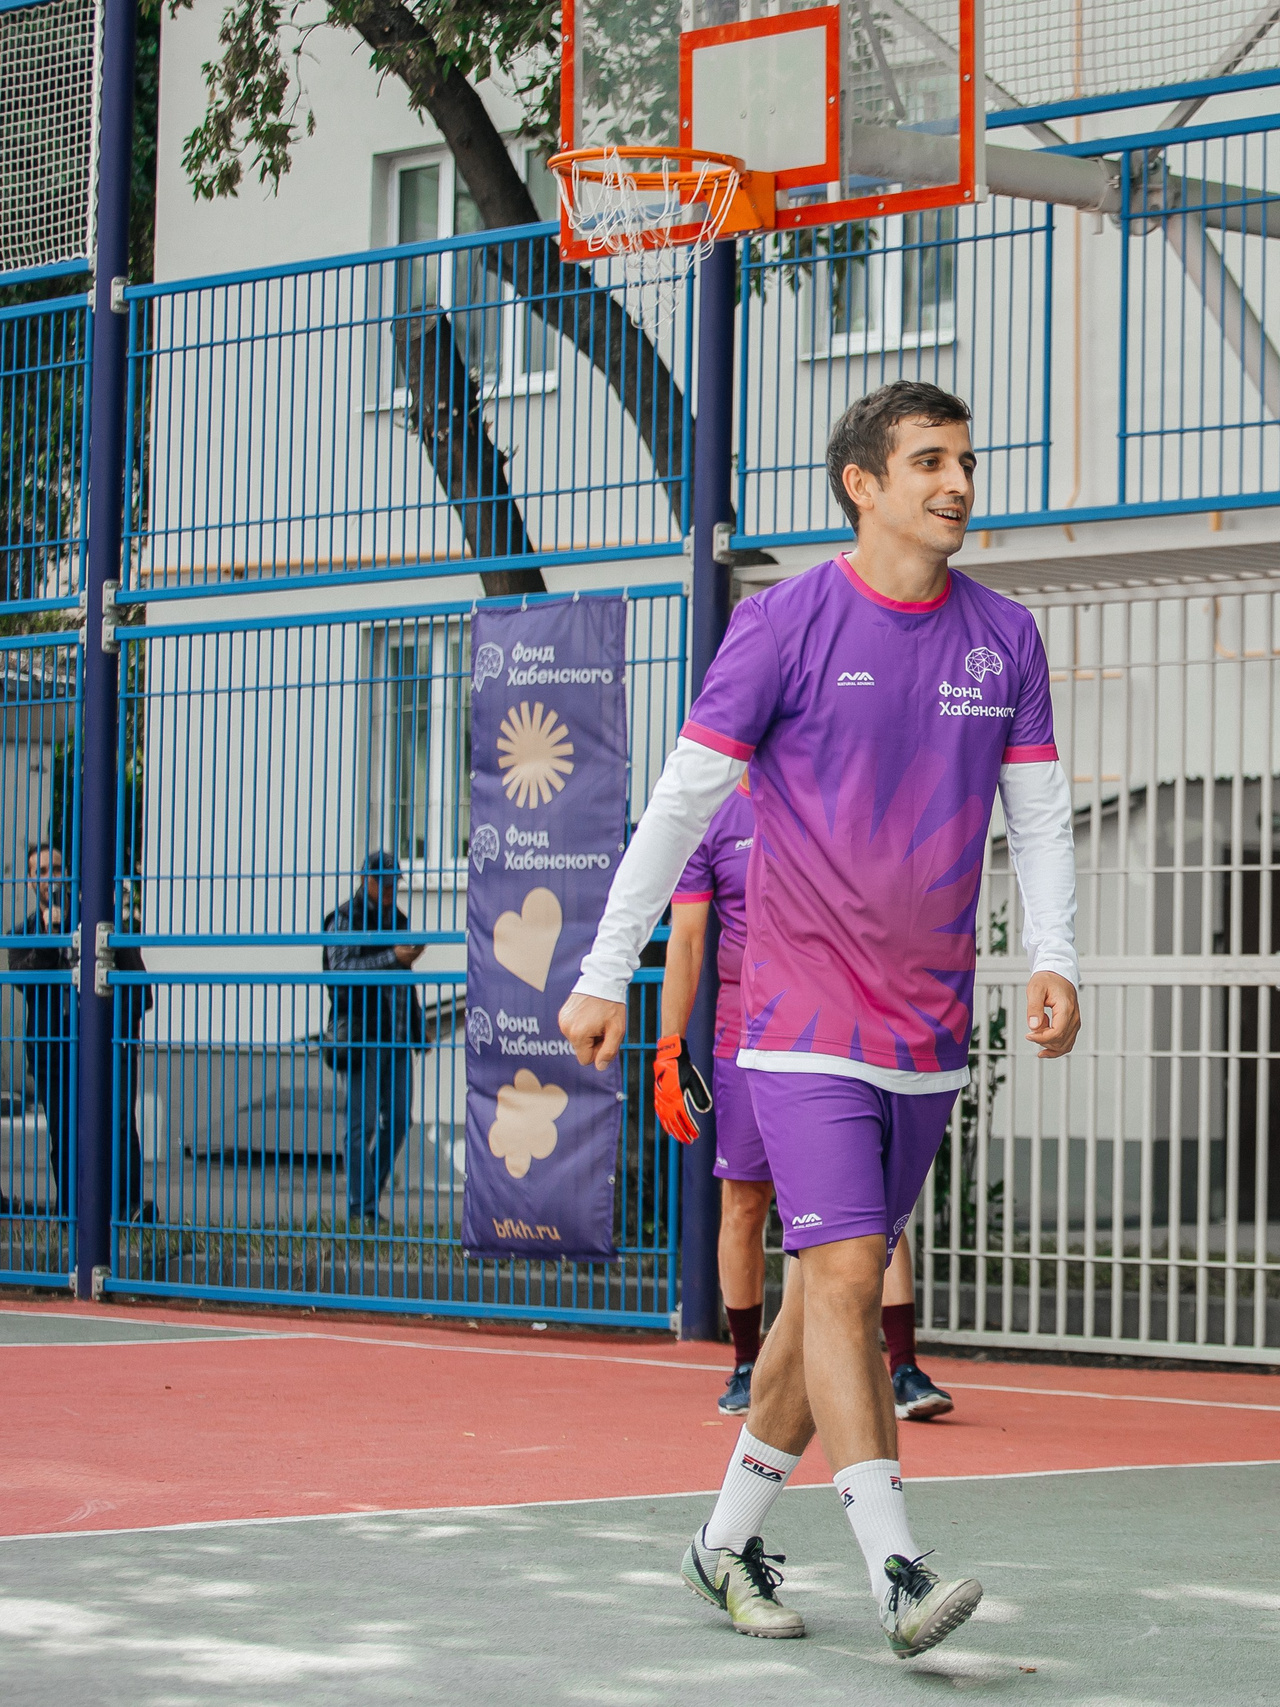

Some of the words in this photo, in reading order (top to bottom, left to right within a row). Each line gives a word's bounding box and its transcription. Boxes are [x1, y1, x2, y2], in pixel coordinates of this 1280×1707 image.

[511, 640, 555, 664] Фонд
[506, 663, 614, 687] Хабенского
[938, 681, 983, 700] Фонд
[505, 823, 549, 849] Фонд
[503, 847, 611, 871] Хабенского
[496, 1008, 540, 1035] Фонд
[492, 1217, 562, 1241] bfkh.ru
[741, 1456, 783, 1481] FILA
